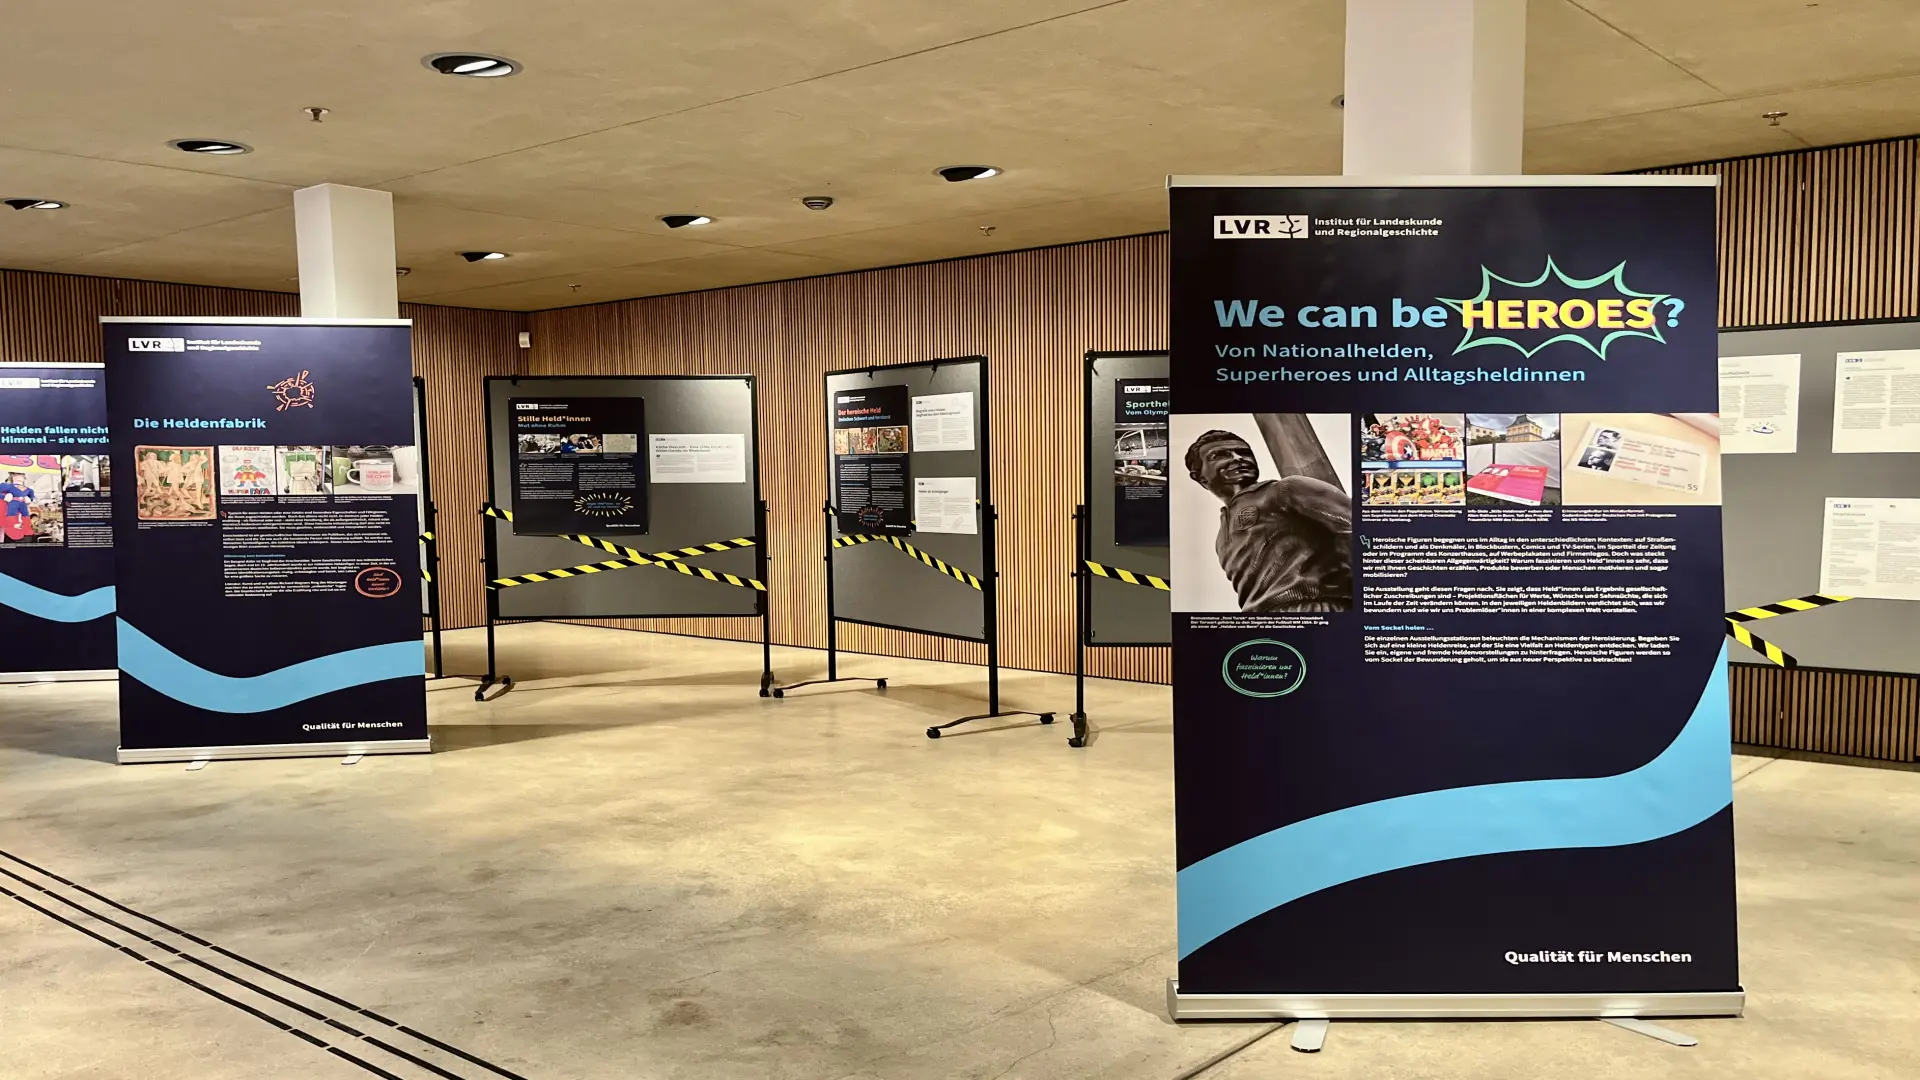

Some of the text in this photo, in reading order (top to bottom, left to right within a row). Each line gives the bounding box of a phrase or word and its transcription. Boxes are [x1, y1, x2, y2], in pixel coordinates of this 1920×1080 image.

[1315, 217, 1443, 226] Institut für Landeskunde
[1219, 219, 1271, 236] LVR
[1314, 227, 1439, 238] und Regionalgeschichte
[1214, 299, 1285, 328] We
[1297, 305, 1378, 328] can
[1392, 297, 1448, 328] be
[132, 341, 161, 349] LVR
[1215, 342, 1434, 361] Von Nationalhelden,
[1216, 366, 1586, 386] Superheroes und Alltagsheldinnen
[134, 417, 267, 429] Die Heldenfabrik
[0, 426, 42, 434] Helden
[44, 426, 78, 434] fallen
[1420, 449, 1456, 459] MARVEL
[302, 722, 340, 731] Qualität
[357, 721, 403, 729] Menschen
[1504, 950, 1692, 965] Qualität für Menschen
